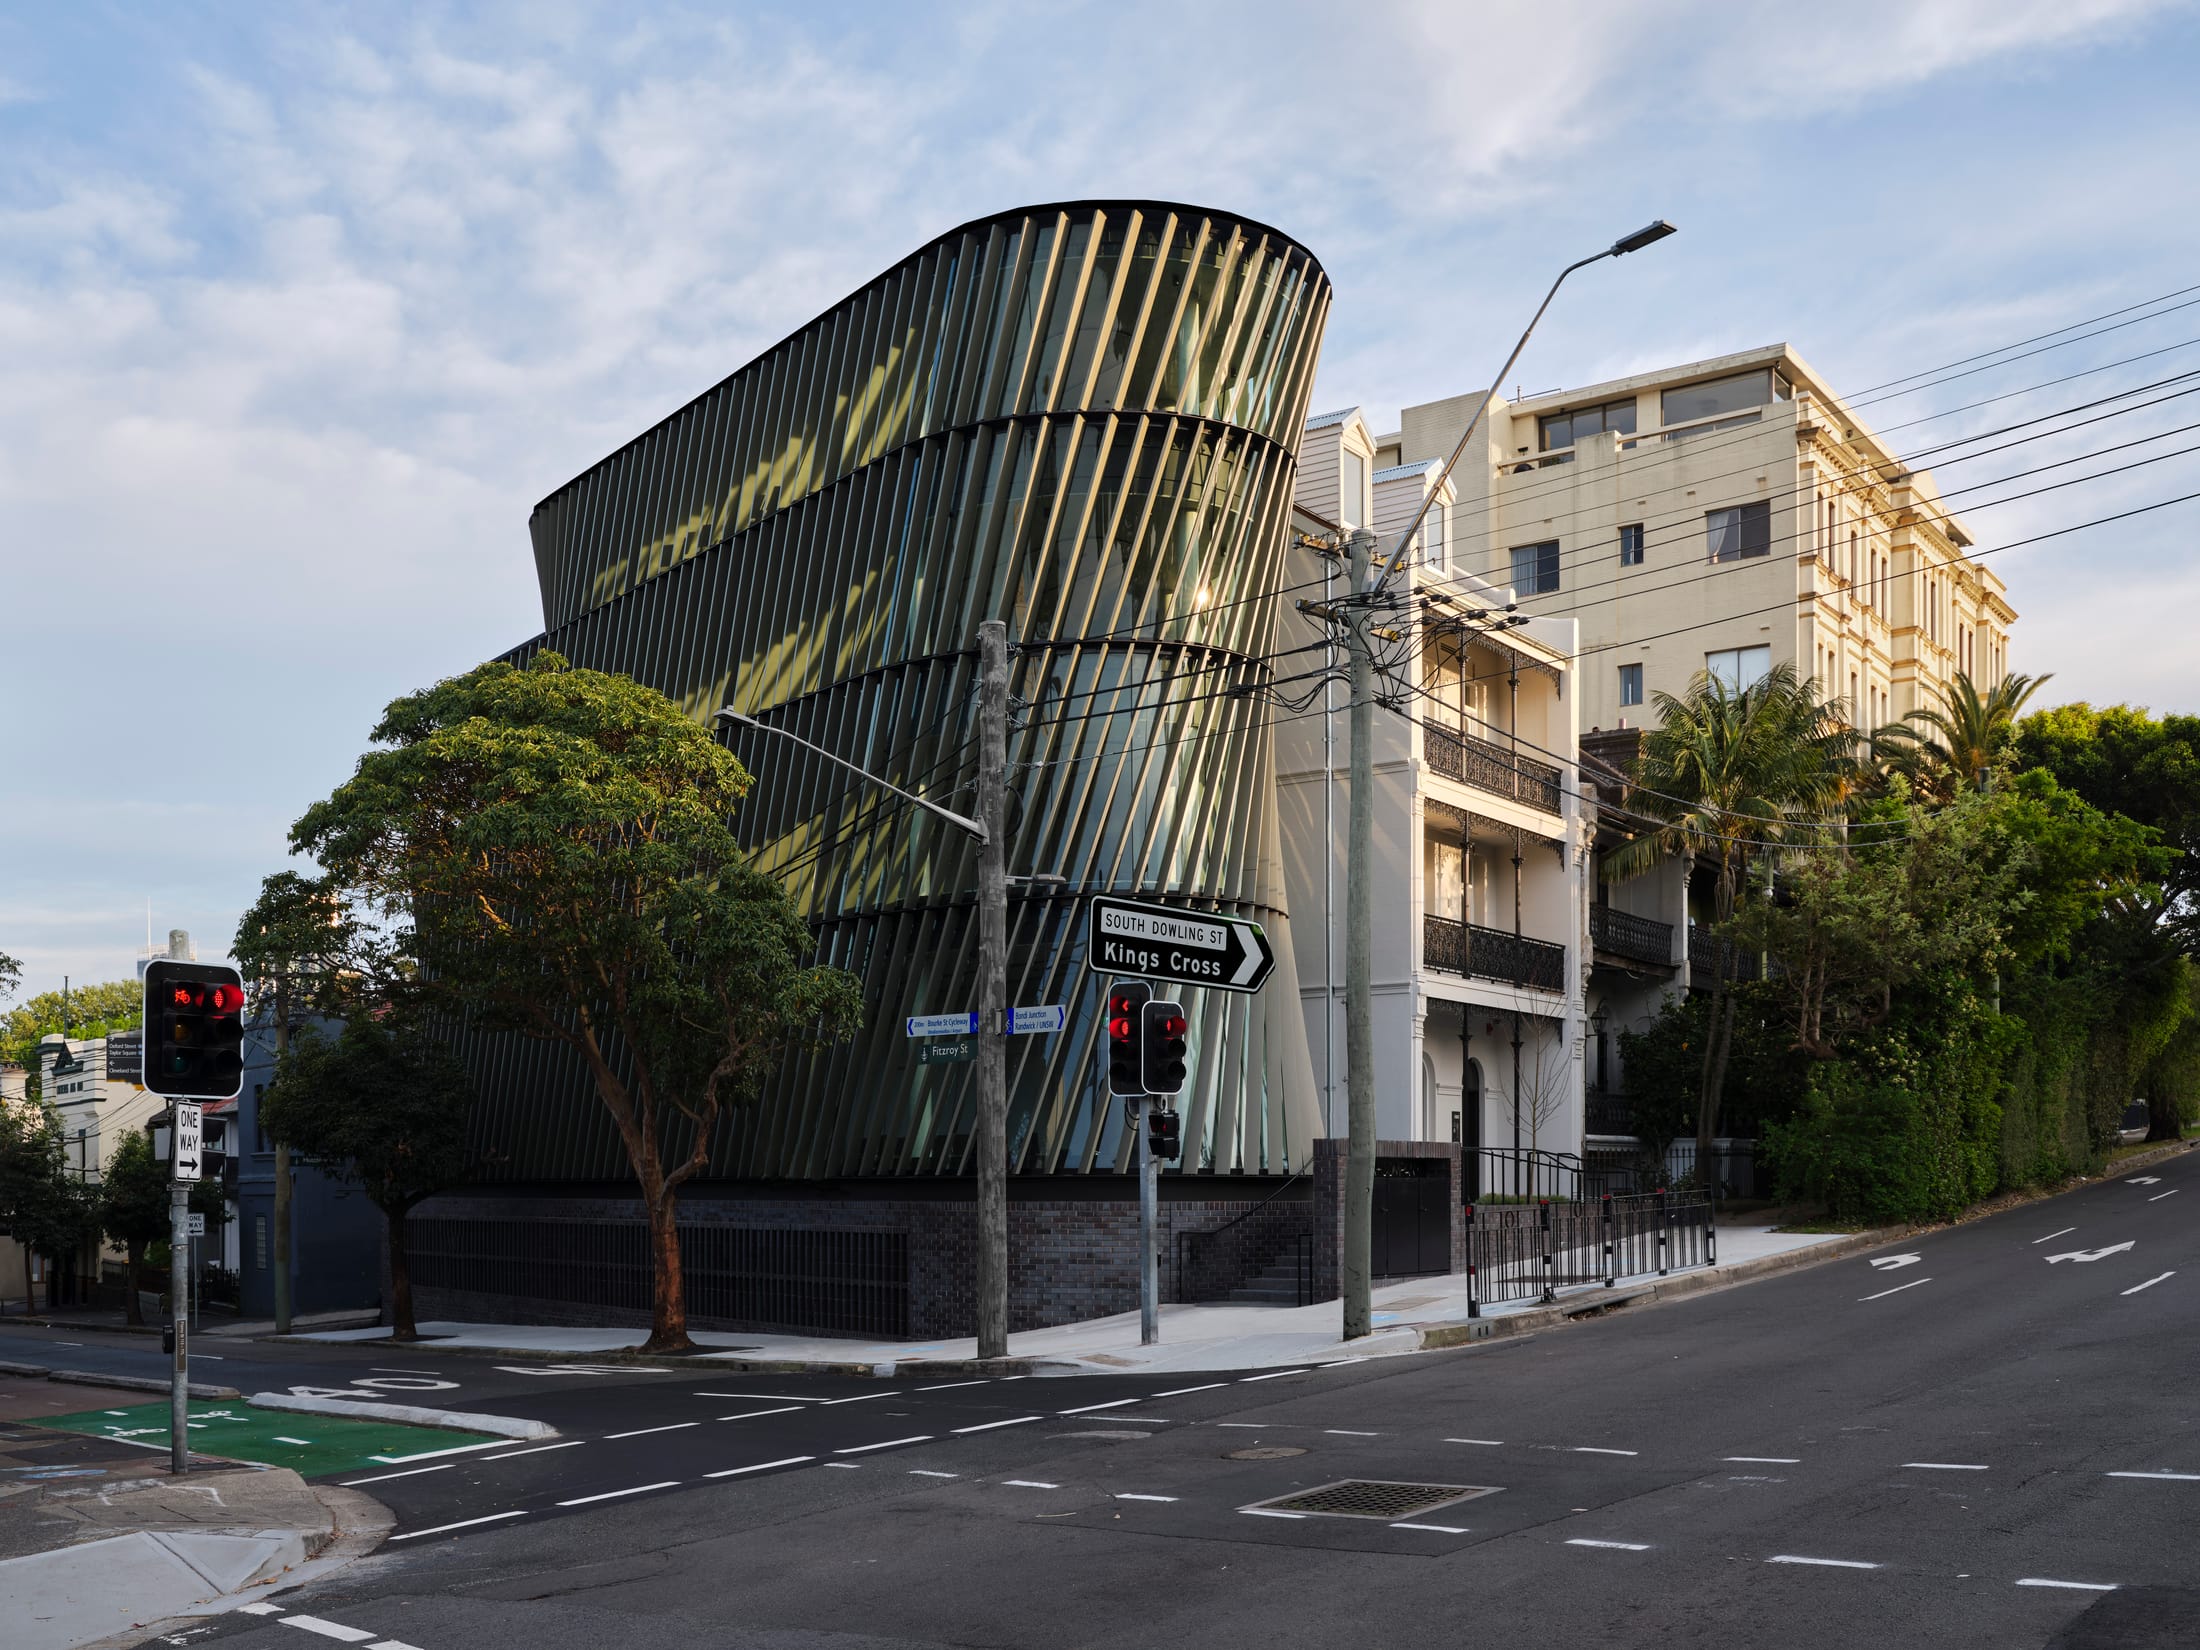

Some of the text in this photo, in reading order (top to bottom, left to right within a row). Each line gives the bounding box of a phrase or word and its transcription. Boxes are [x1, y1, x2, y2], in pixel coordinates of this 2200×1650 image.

[1105, 913, 1223, 945] SOUTH DOWLING ST
[1105, 941, 1221, 976] Kings Cross
[943, 1018, 948, 1026] St
[932, 1043, 968, 1057] Fitzroy St
[181, 1110, 198, 1128] ONE
[180, 1134, 198, 1151] WAY
